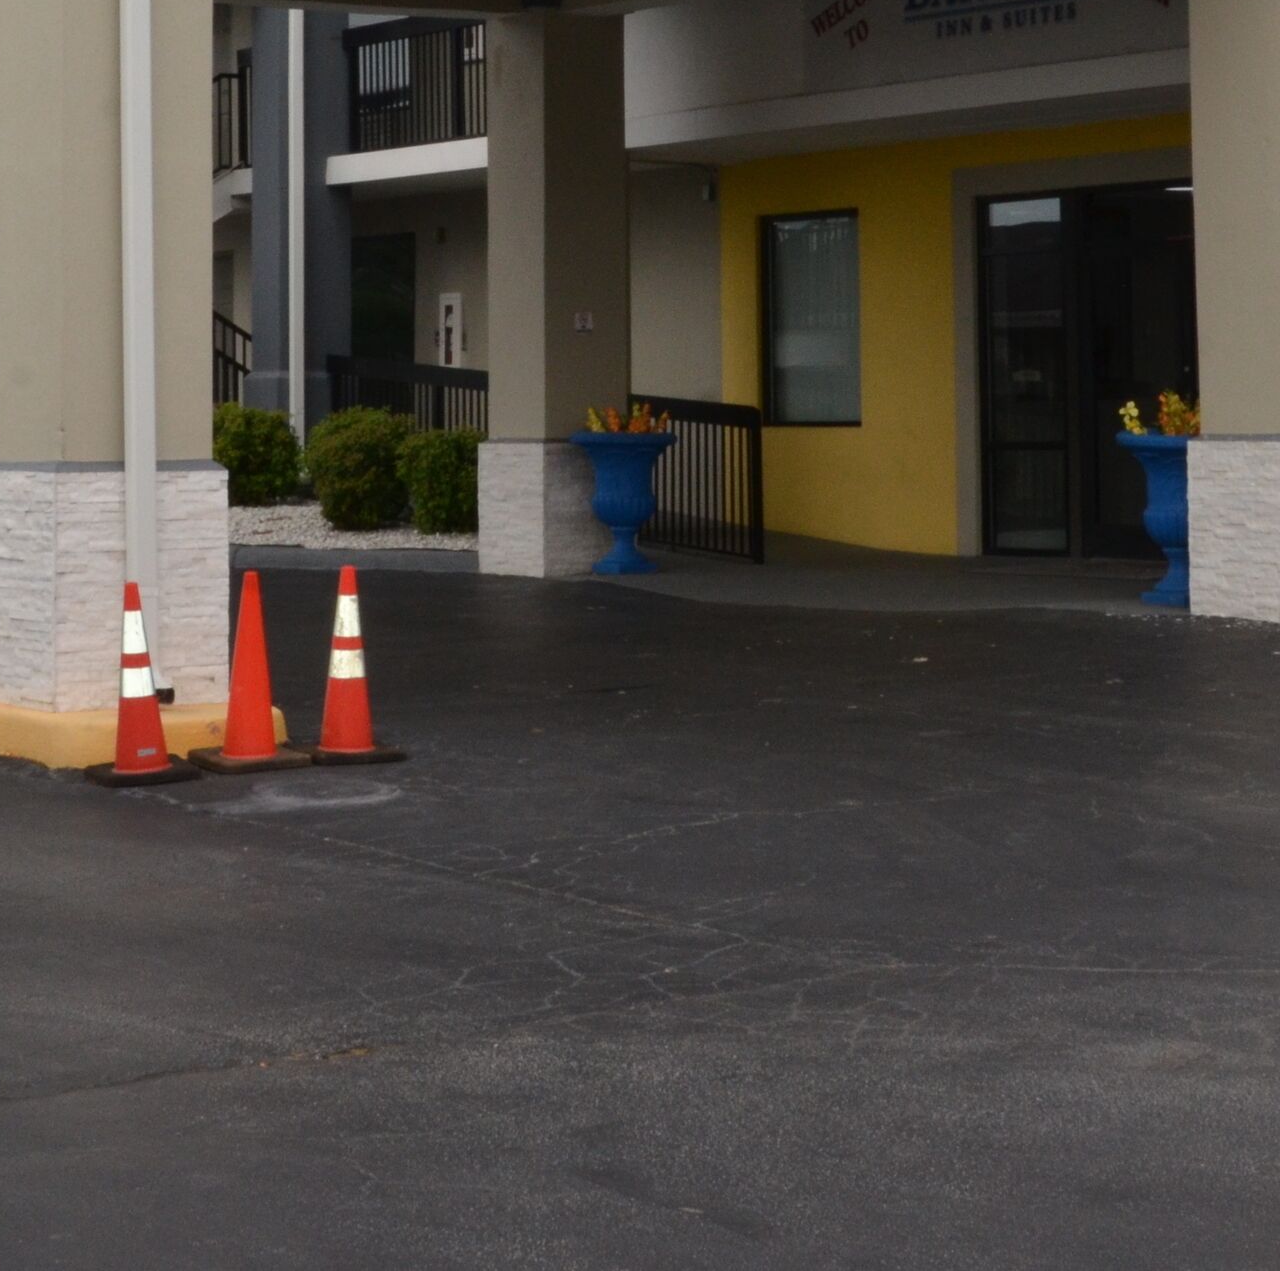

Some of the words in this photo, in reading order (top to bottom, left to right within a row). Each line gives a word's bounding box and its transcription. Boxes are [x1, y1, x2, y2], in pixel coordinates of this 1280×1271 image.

[844, 19, 869, 49] TO
[936, 16, 972, 39] INN
[980, 14, 993, 33] &
[1003, 1, 1076, 29] SUITES
